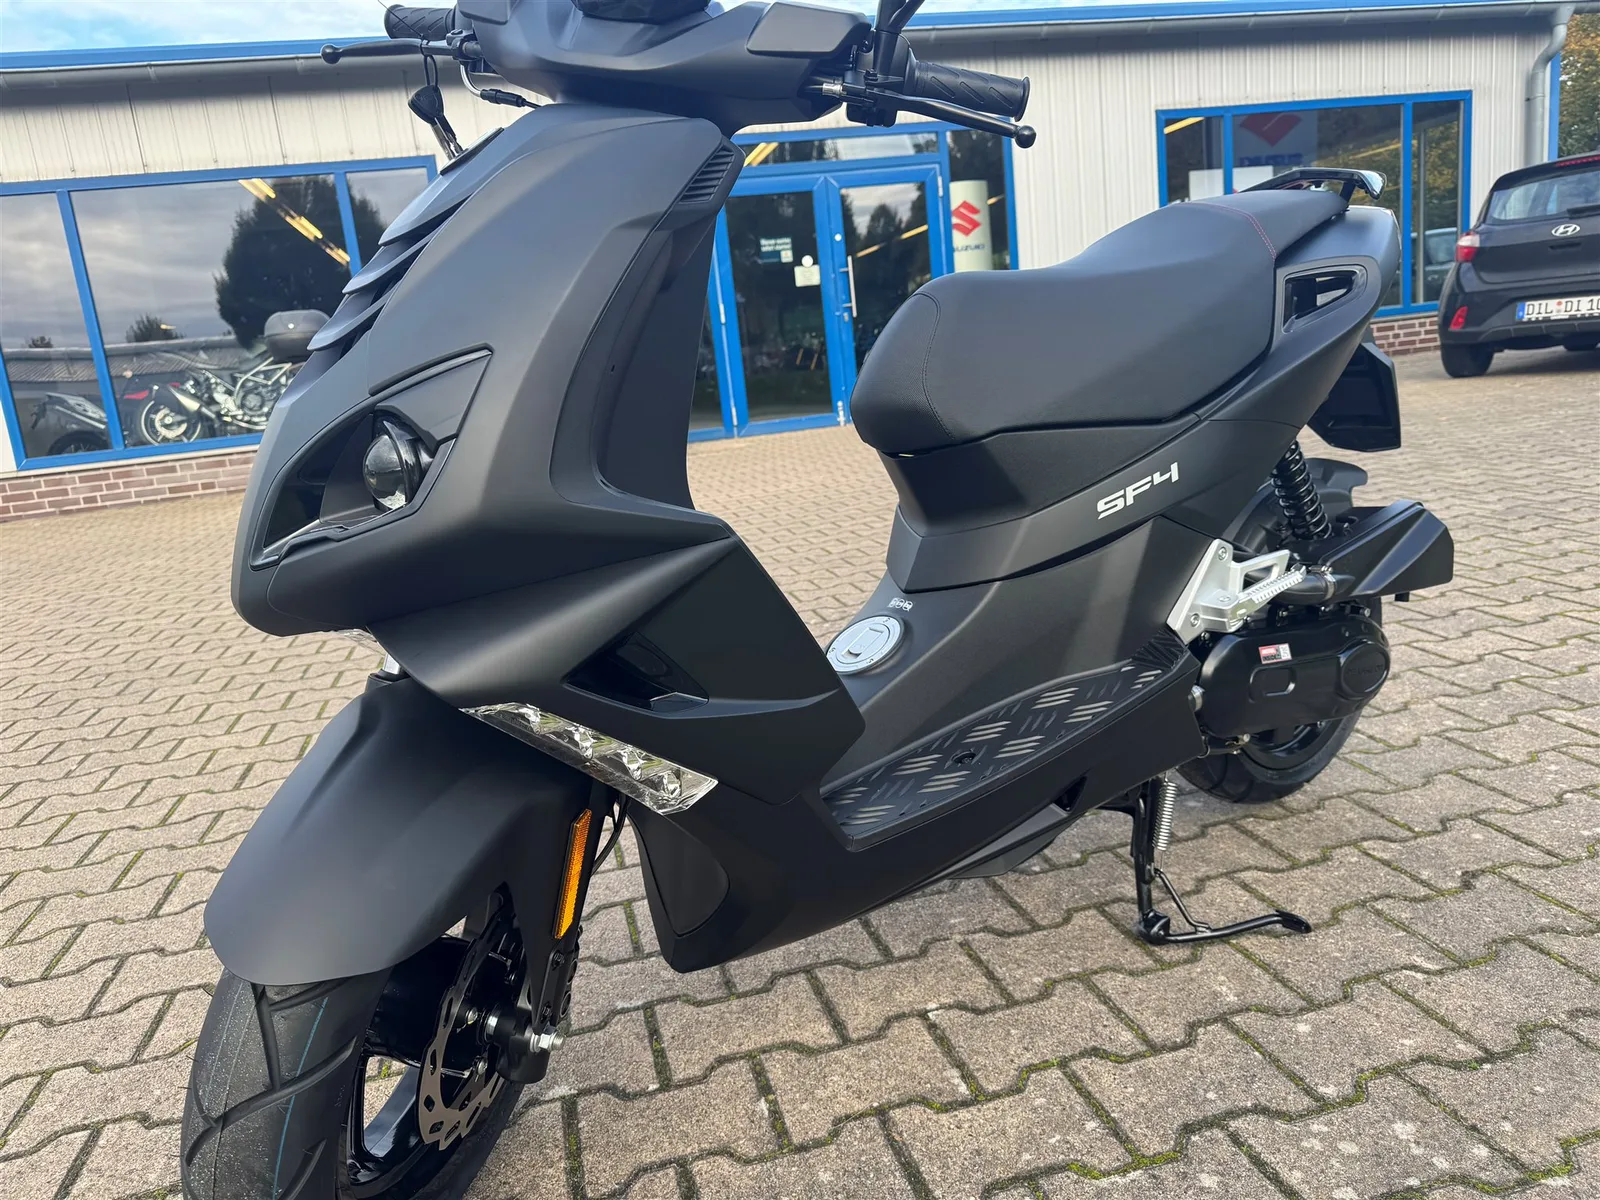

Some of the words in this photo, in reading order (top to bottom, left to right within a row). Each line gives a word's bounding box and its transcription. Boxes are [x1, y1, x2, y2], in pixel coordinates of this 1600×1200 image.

[1526, 303, 1553, 315] DIL
[1564, 300, 1582, 313] DI
[1097, 461, 1179, 520] SF4
